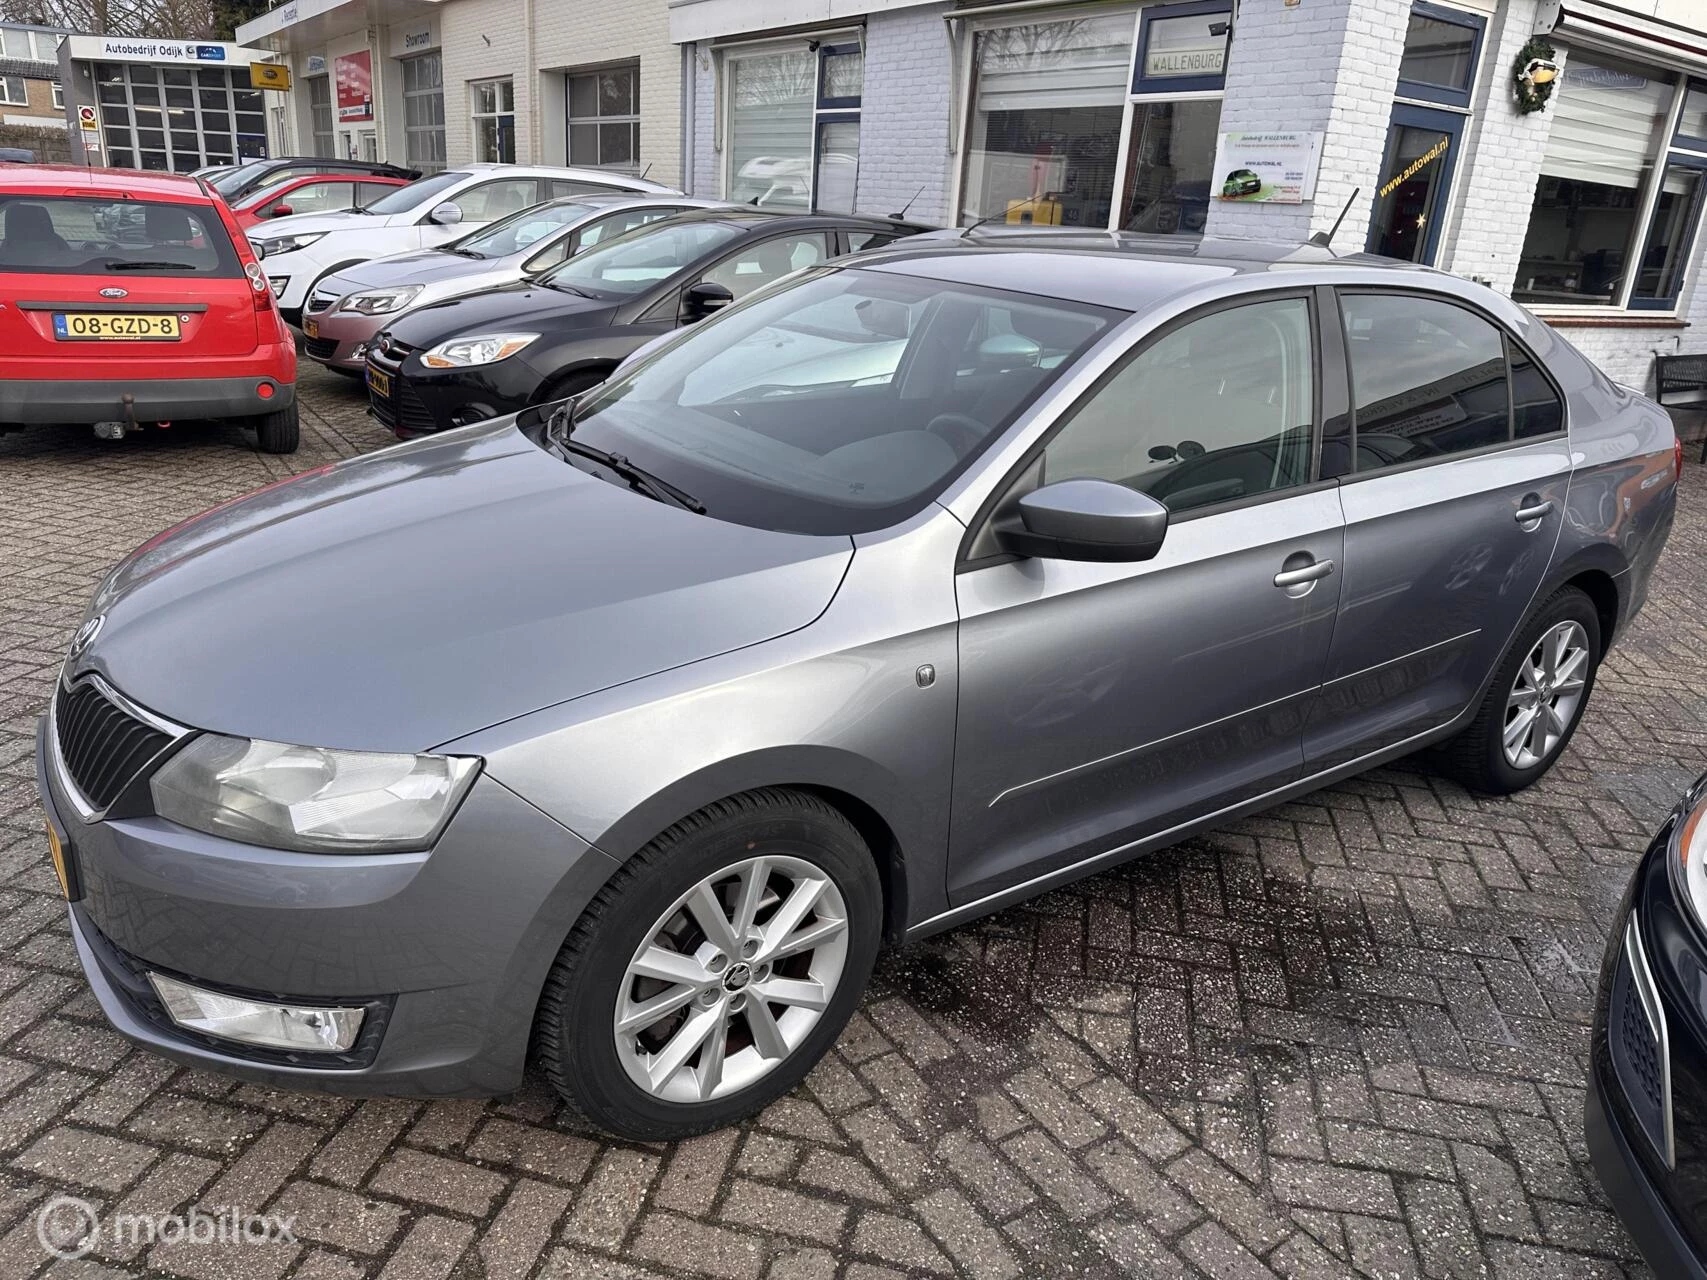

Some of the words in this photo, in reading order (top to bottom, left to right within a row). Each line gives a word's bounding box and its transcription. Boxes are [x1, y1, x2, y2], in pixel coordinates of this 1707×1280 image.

[105, 43, 156, 57] Autobedrijf
[159, 45, 183, 58] Odijk
[1152, 53, 1223, 72] WALLENBURG
[1380, 136, 1449, 198] www.autowal.nl
[57, 327, 66, 335] NL
[72, 317, 173, 335] 08-GZD-8
